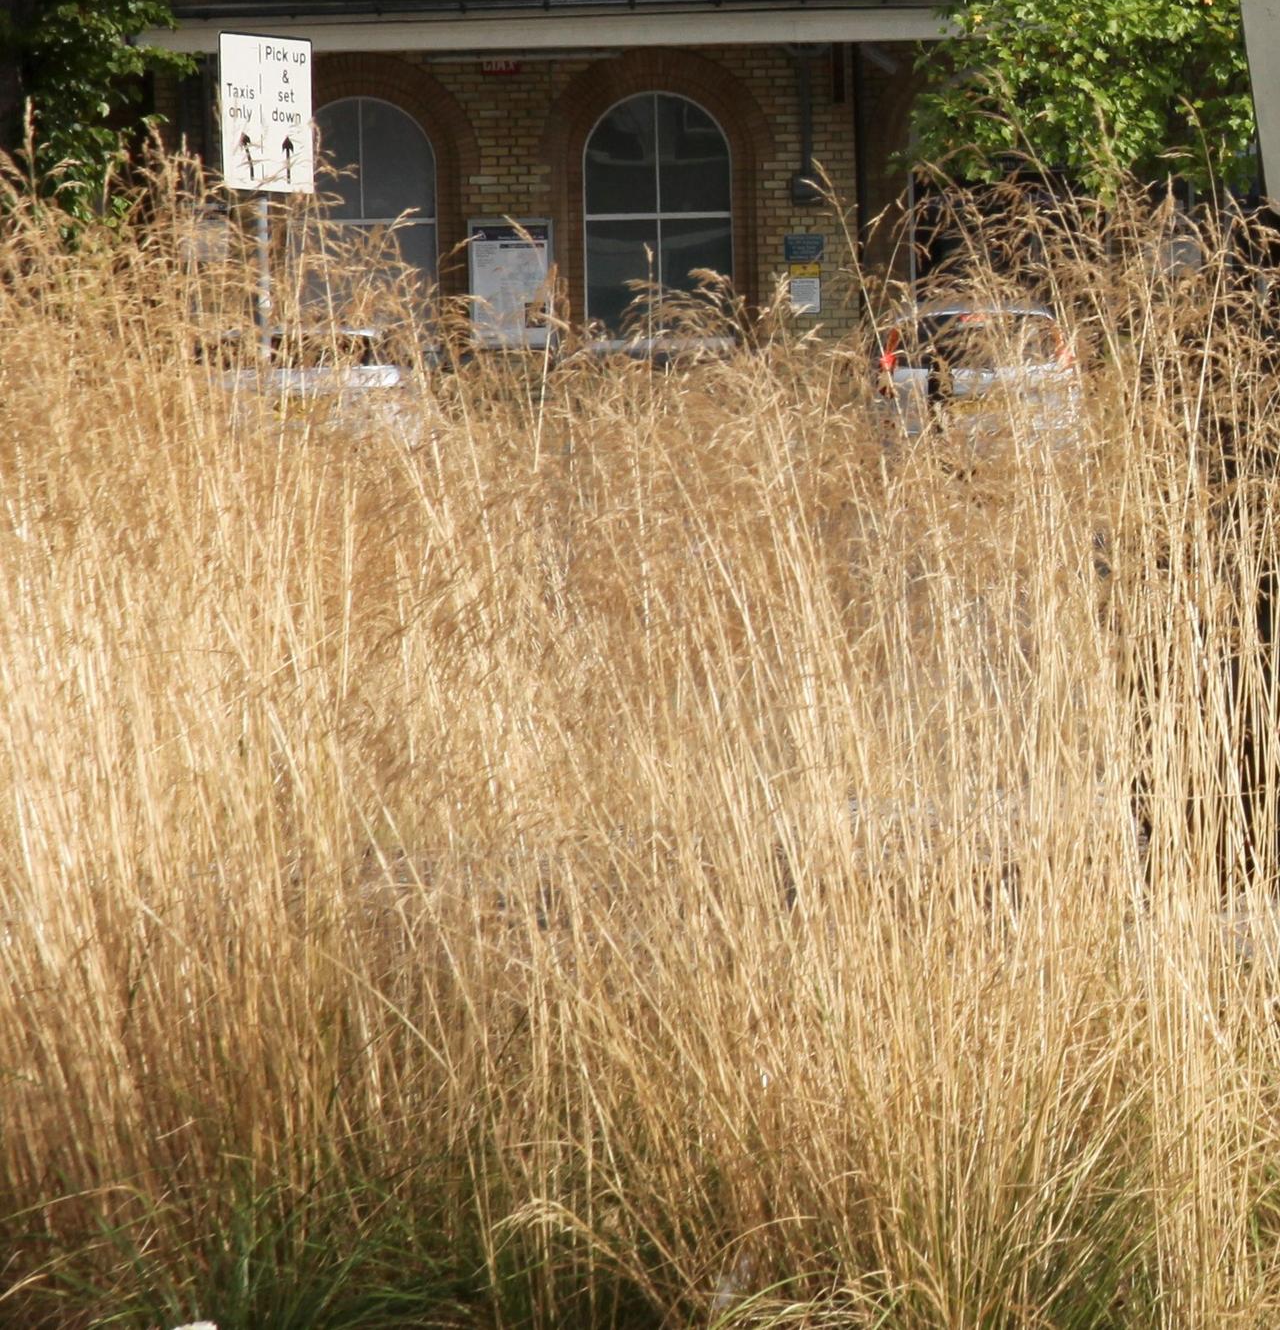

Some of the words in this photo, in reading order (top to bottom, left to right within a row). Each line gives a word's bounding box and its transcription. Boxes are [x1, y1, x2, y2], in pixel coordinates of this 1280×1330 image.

[265, 45, 288, 62] Pick
[292, 52, 306, 65] up
[282, 69, 290, 84] &
[226, 82, 255, 100] Taxis
[278, 90, 296, 103] set
[228, 104, 253, 123] only
[272, 108, 302, 124] down
